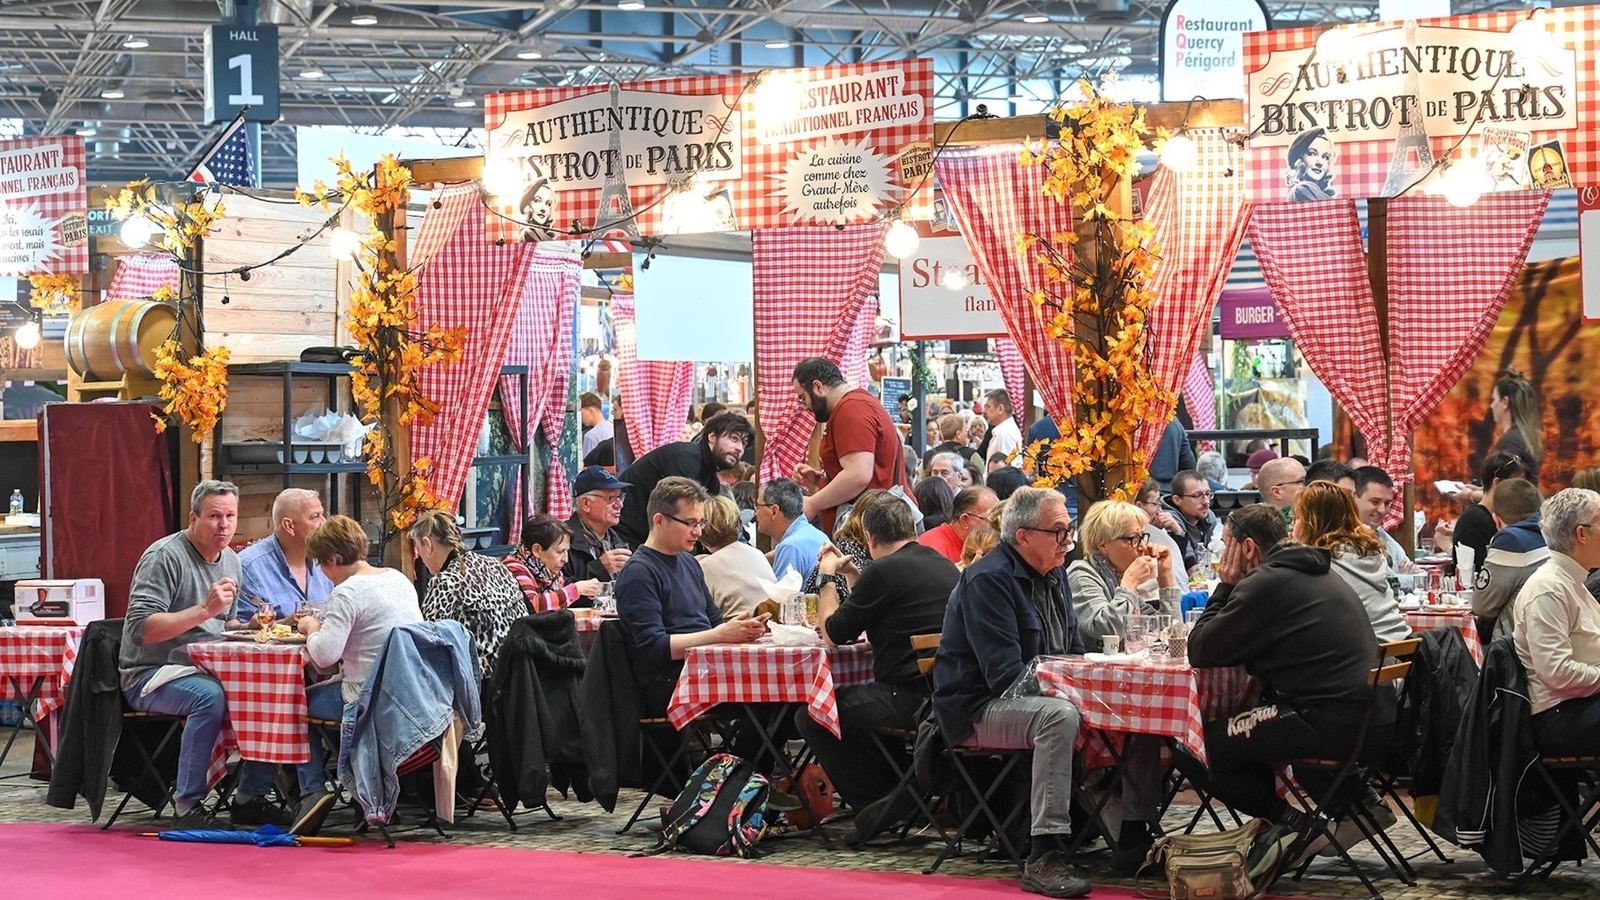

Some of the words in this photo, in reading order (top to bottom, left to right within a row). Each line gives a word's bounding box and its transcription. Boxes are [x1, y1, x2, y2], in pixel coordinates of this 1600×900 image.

[1176, 14, 1253, 31] Restaurant
[229, 30, 259, 42] HALL
[1176, 33, 1224, 53] Quercy
[1175, 50, 1236, 72] Périgord
[1292, 45, 1526, 92] AUHENTIQUE
[228, 53, 264, 105] 1
[800, 75, 899, 111] ESTAURANT
[856, 101, 919, 125] FRANÇAIS
[1261, 94, 1419, 136] BISTROT
[1426, 100, 1447, 118] DE
[1452, 85, 1567, 124] PARIS
[523, 106, 704, 147] AUTHENTIQUE
[508, 149, 622, 182] ISTROT
[626, 155, 643, 169] DE
[646, 141, 734, 175] PARIS
[808, 153, 826, 168] La
[827, 152, 863, 166] cuisine
[901, 152, 932, 166] BISTROT
[803, 170, 841, 182] comme
[843, 166, 869, 179] chez
[903, 162, 933, 179] PARIS
[0, 179, 25, 195] NNEL
[27, 172, 75, 191] FRANÇAIS
[801, 180, 870, 197] Grand-Mère
[812, 195, 859, 215] autrefois
[21, 225, 44, 236] souris
[65, 229, 87, 243] PARIS
[89, 225, 113, 234] EXIT
[26, 238, 46, 250] mais
[1235, 306, 1274, 325] BURGER
[1227, 704, 1278, 739] Kaporal
